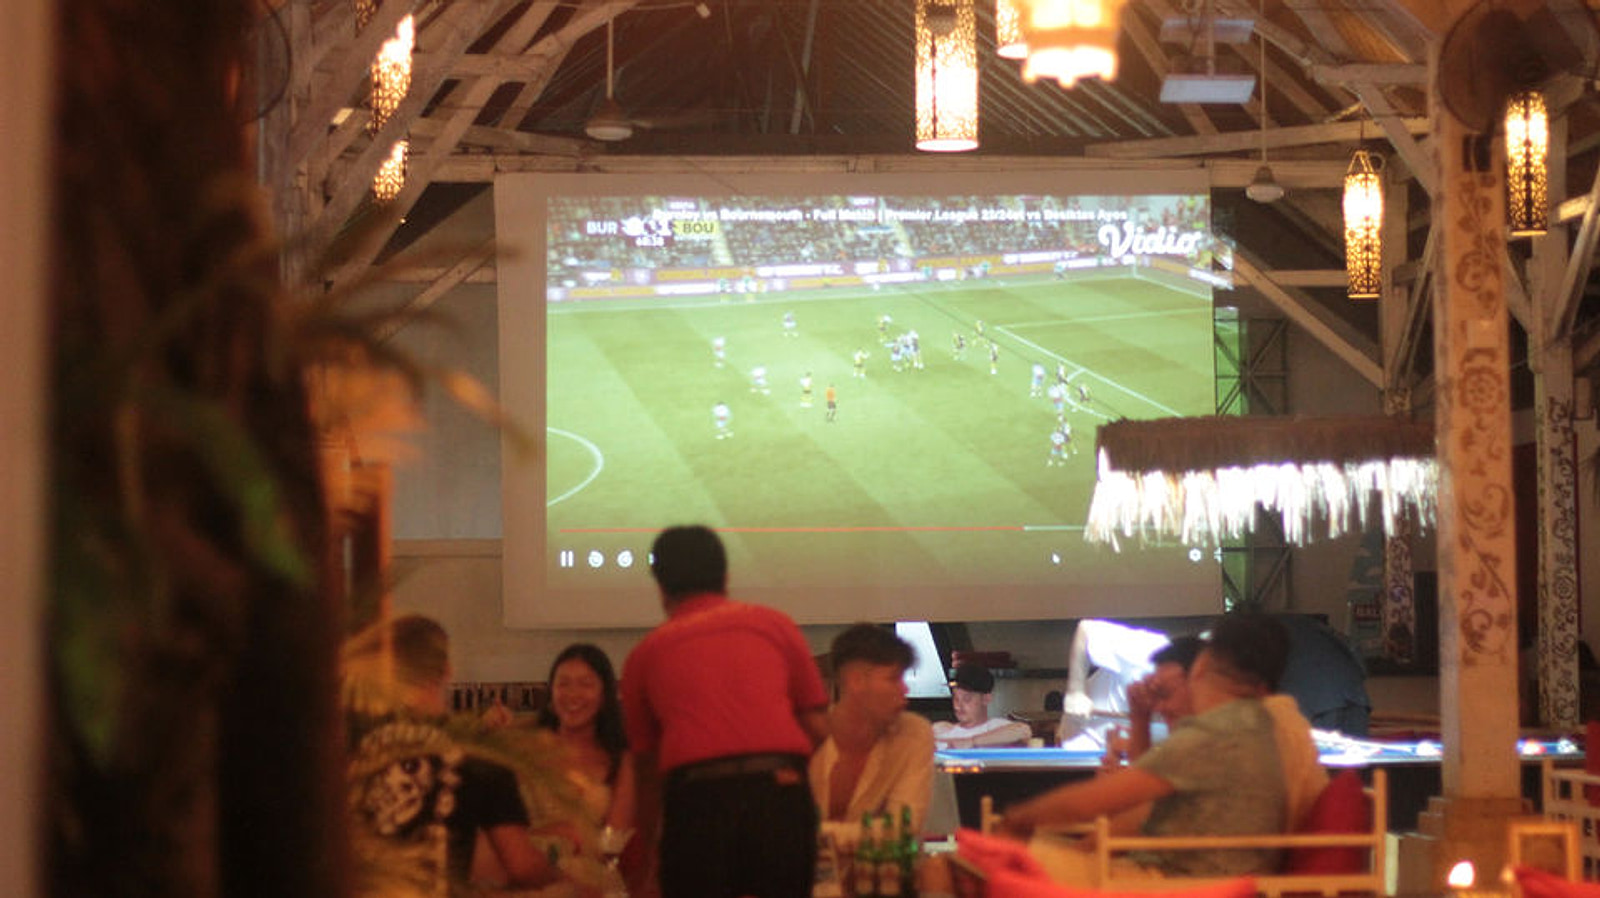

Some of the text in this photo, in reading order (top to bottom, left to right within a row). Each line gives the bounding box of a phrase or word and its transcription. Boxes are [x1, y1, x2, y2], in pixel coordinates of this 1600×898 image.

[935, 208, 978, 222] League
[586, 220, 618, 235] BUR
[682, 222, 714, 234] BOU
[1097, 221, 1202, 259] Vidio
